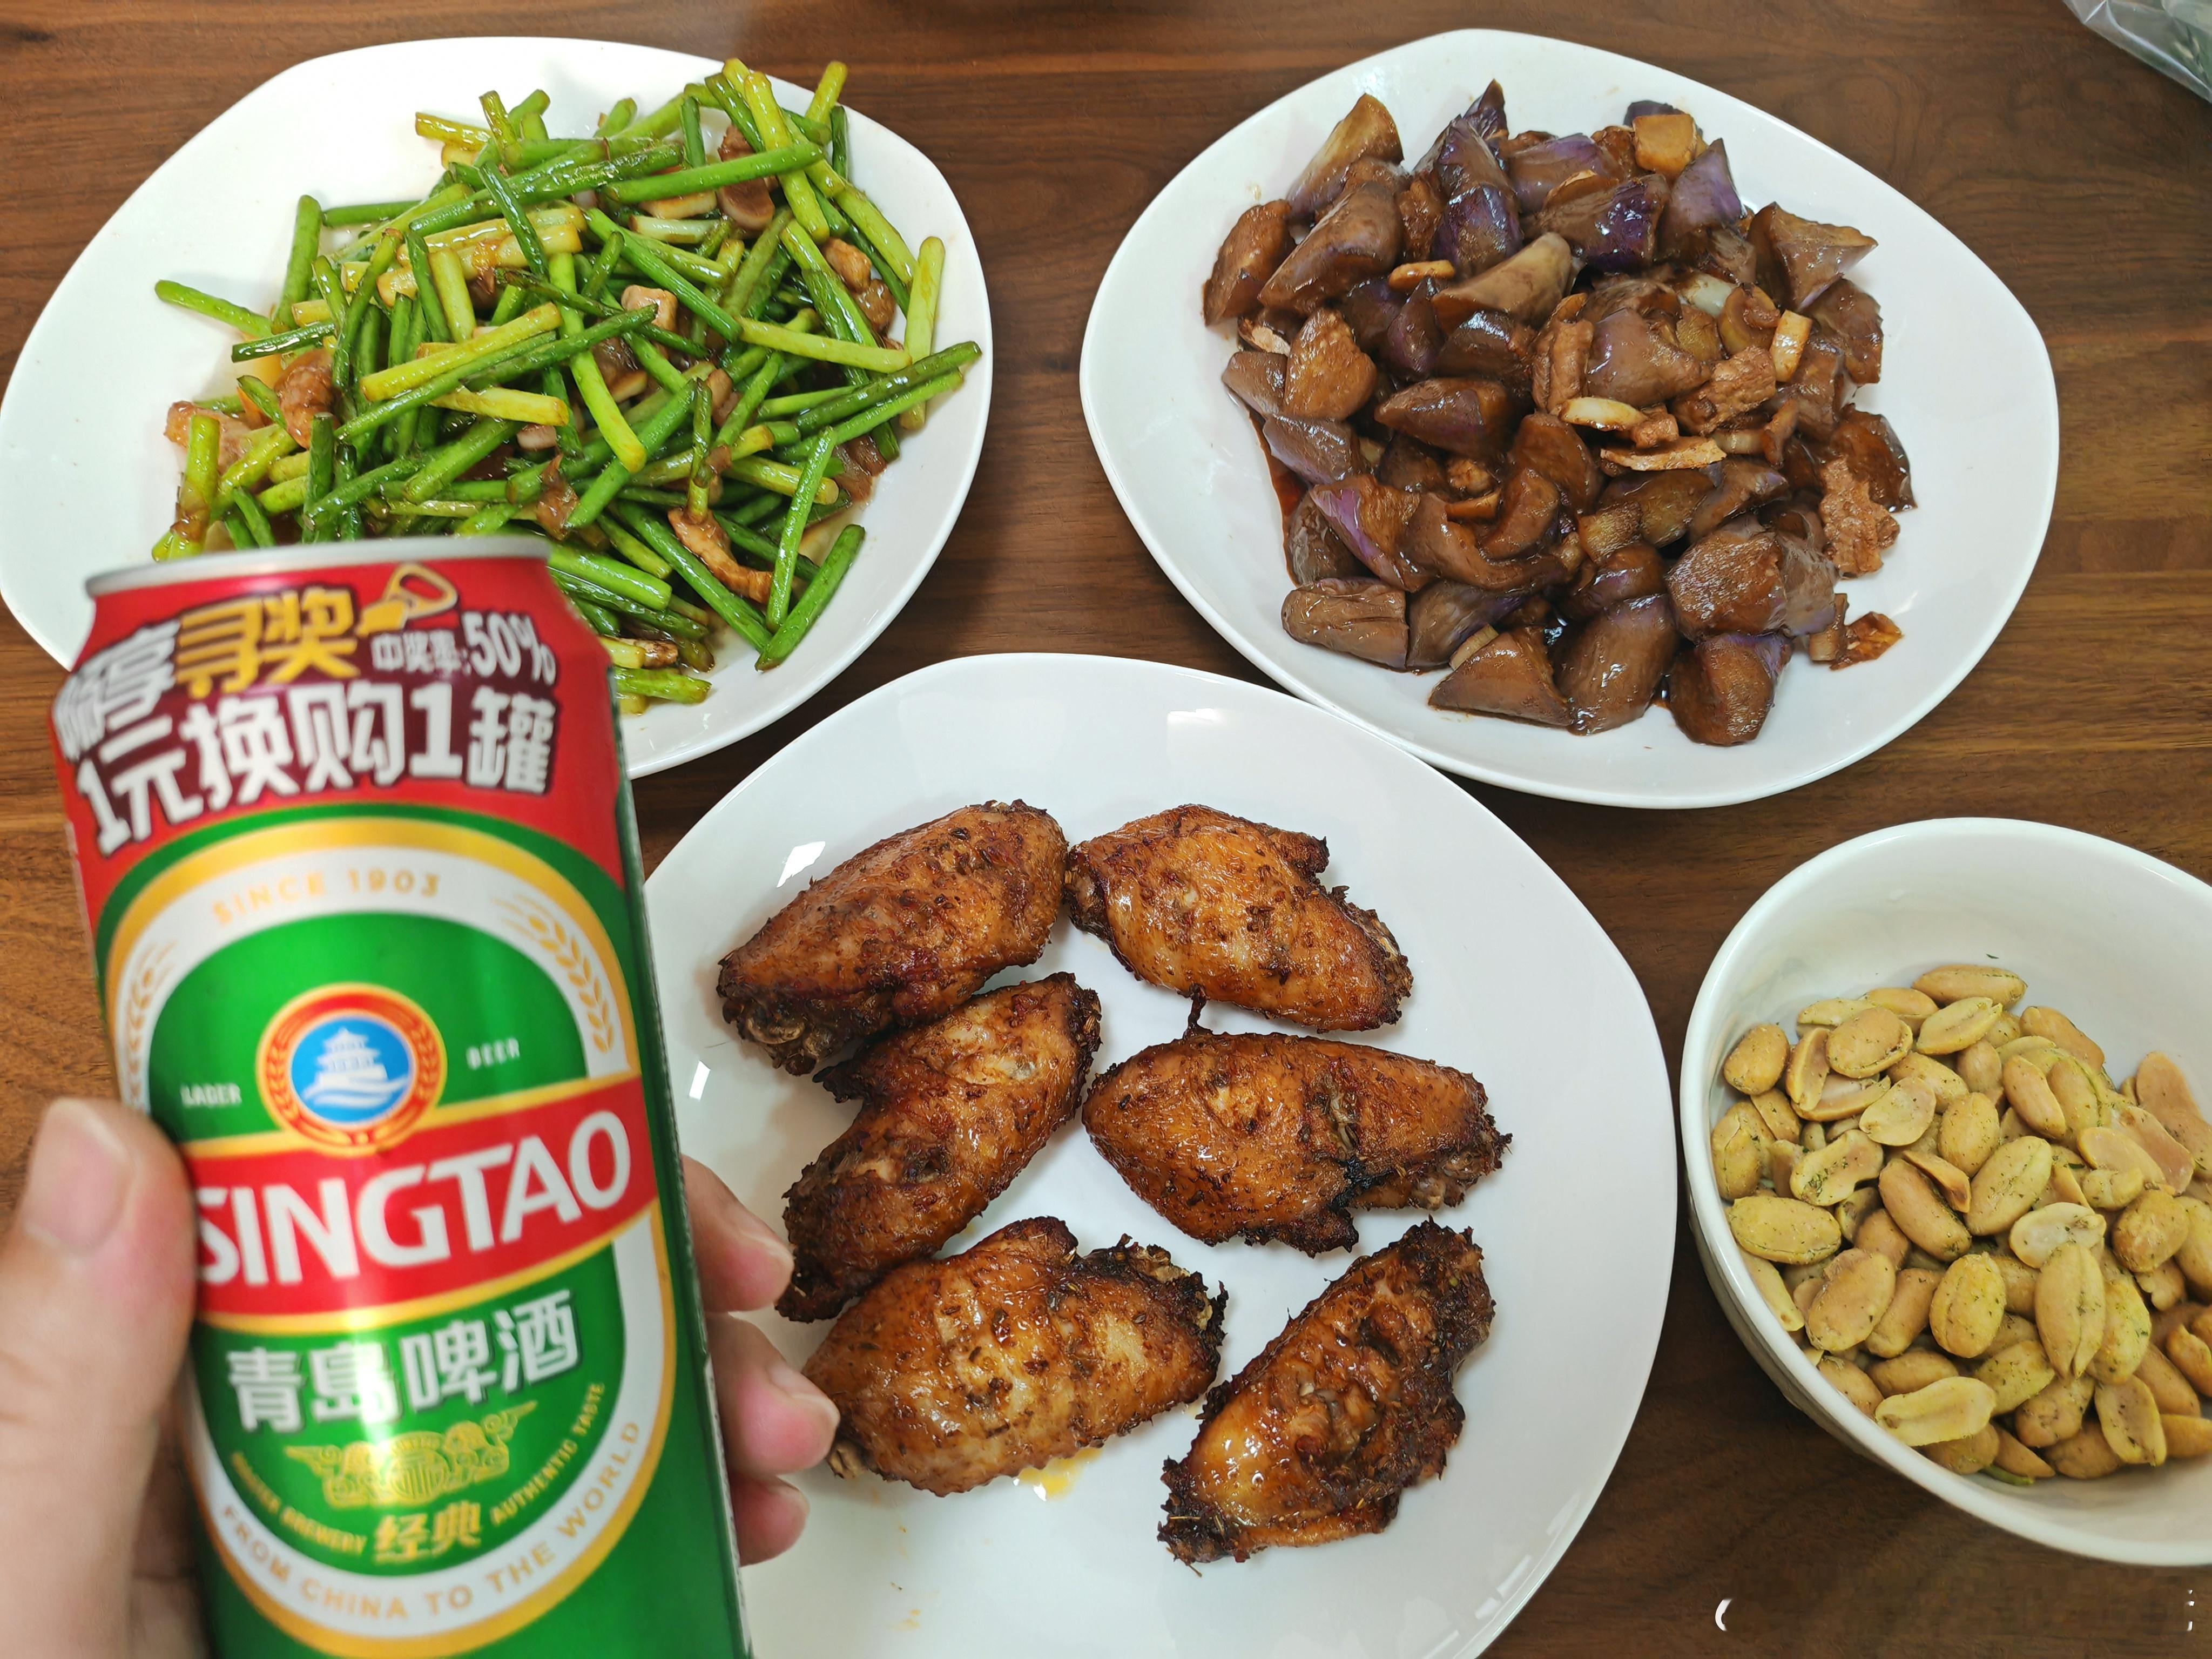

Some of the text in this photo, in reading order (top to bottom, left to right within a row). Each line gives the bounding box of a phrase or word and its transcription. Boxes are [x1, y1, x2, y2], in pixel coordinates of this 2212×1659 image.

[78, 681, 556, 855] 1元换购1罐
[213, 869, 440, 925] SINCE 1903
[467, 1038, 520, 1069] BEER
[197, 1111, 631, 1286] SINGTAO
[227, 1290, 581, 1432] 青岛啤酒
[224, 1422, 640, 1620] FROM CHINA TO THE WORLD
[374, 1501, 481, 1564] 经典
